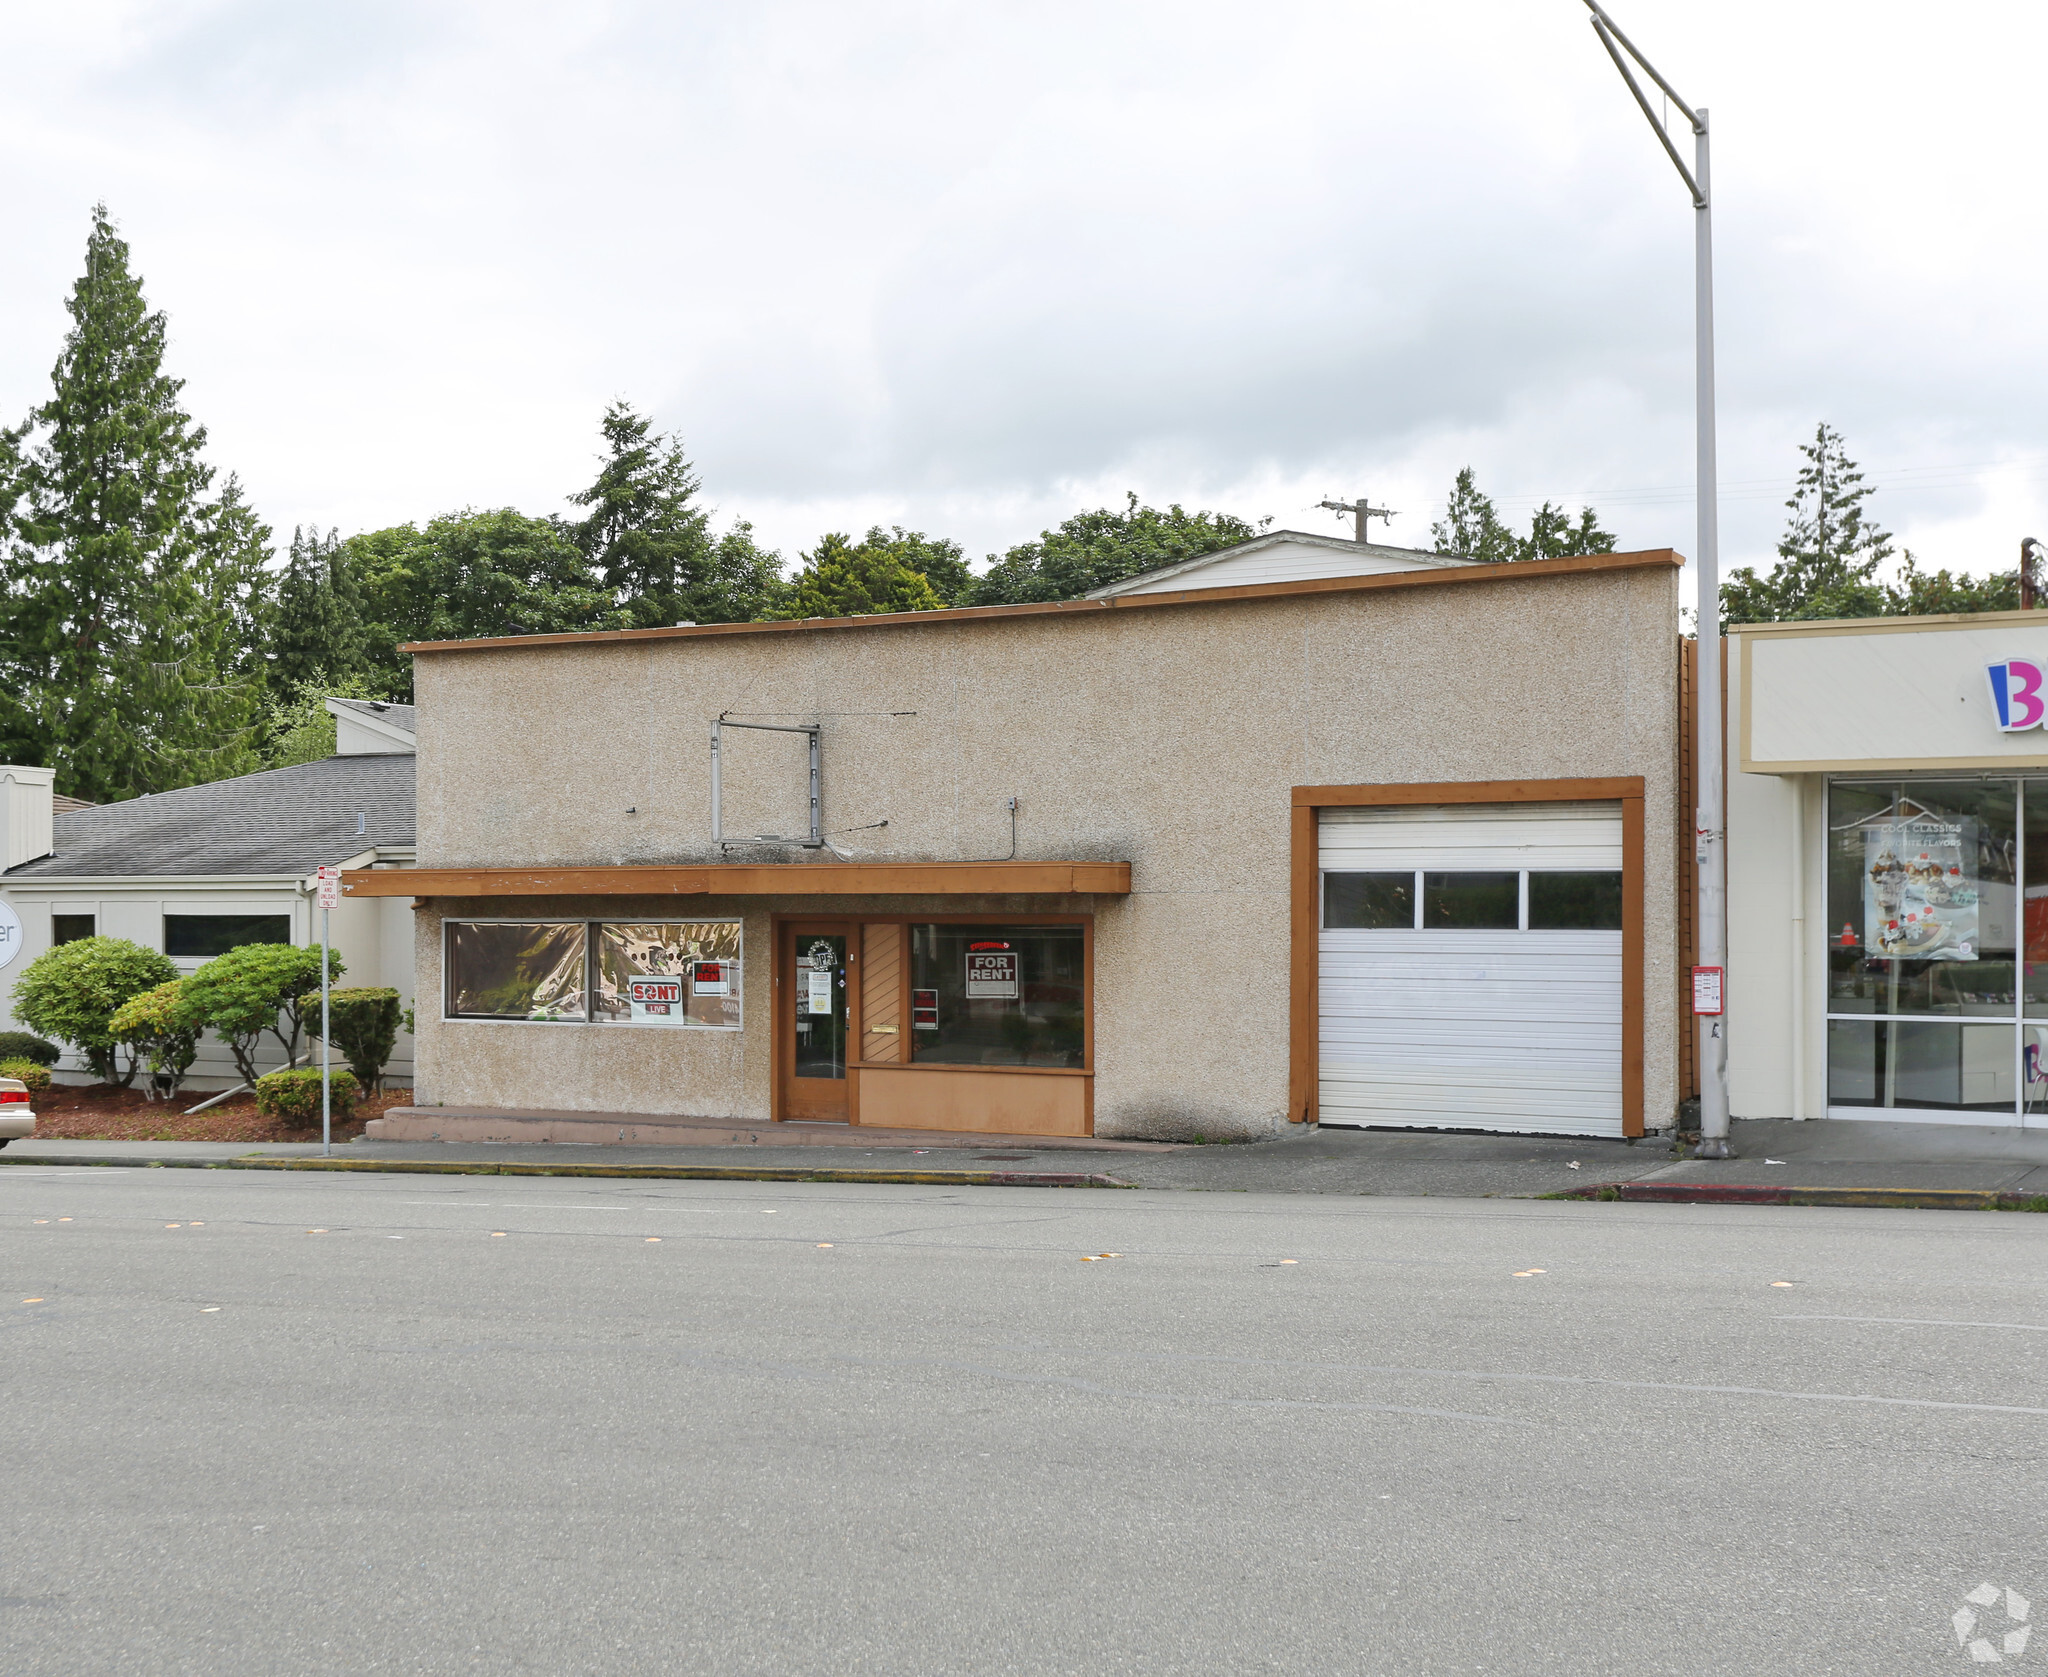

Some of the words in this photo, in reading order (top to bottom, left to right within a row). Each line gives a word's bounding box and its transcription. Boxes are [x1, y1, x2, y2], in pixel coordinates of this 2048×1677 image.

[1881, 825, 1909, 833] COOL
[1913, 824, 1962, 833] CLASSICS
[1924, 839, 1962, 847] FLAVORS
[975, 957, 1008, 968] FOR
[702, 964, 721, 972] FOR
[697, 973, 726, 981] RENT
[970, 968, 1014, 980] RENT
[649, 1005, 666, 1013] LIVE
